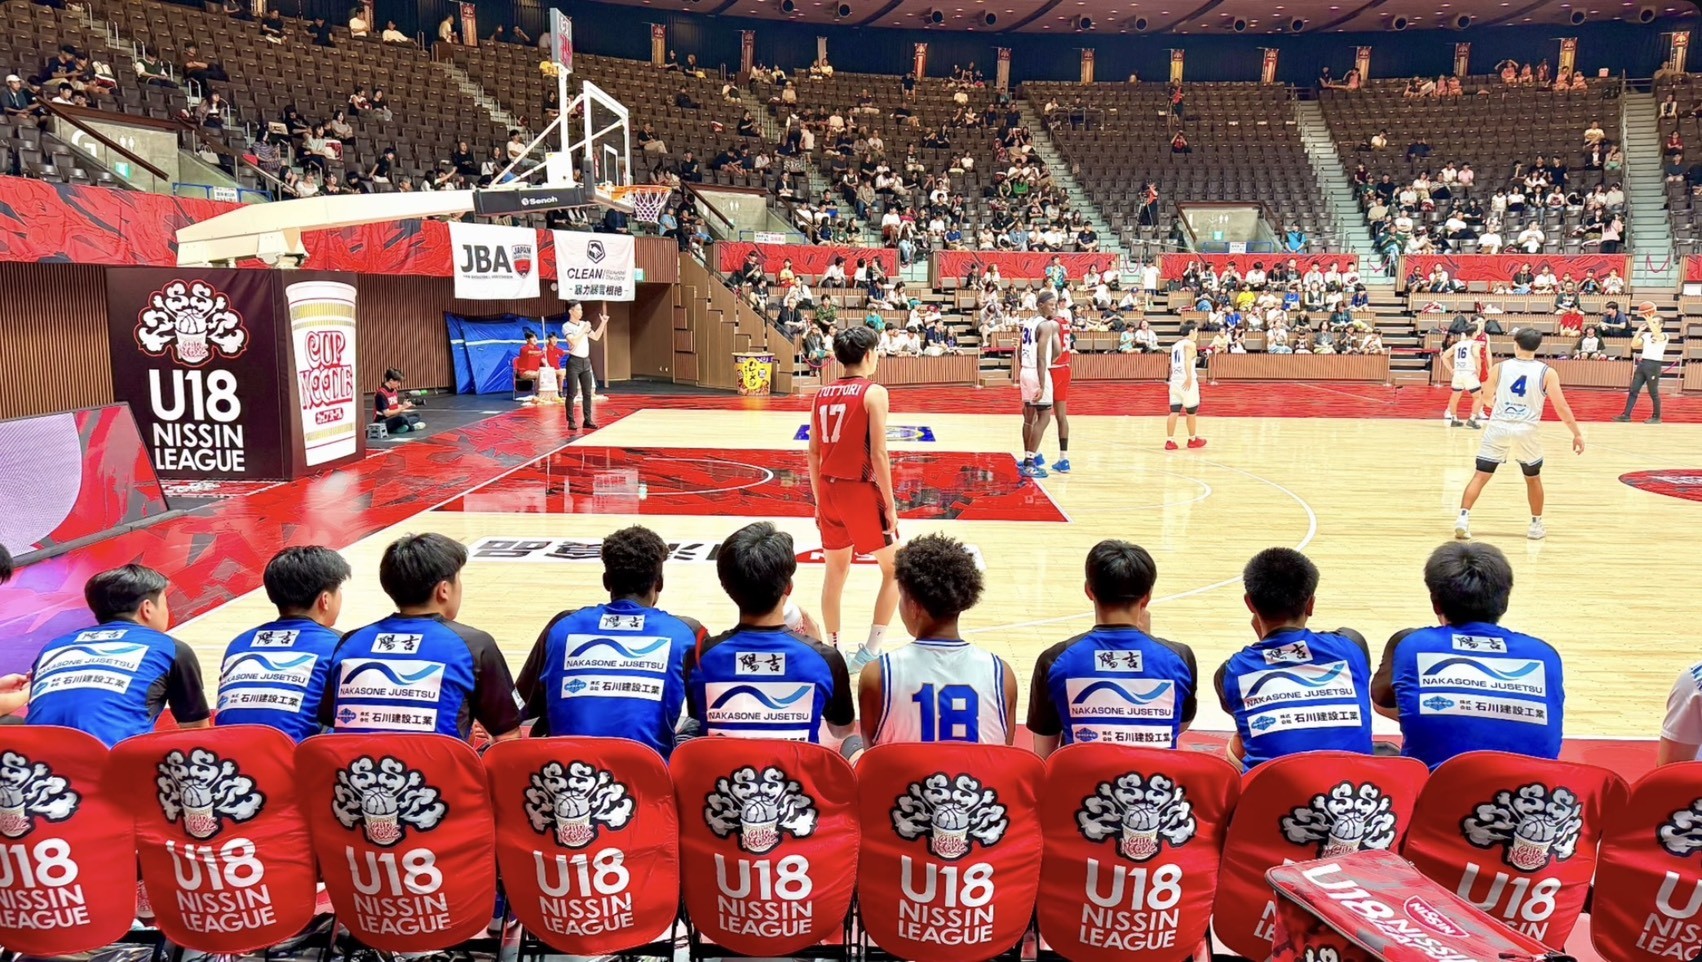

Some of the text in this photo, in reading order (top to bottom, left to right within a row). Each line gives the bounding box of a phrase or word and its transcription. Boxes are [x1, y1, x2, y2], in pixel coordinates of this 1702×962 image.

[529, 195, 558, 205] Senoh
[460, 244, 512, 273] JBA
[567, 267, 603, 280] CLEAN
[305, 331, 346, 369] CUP
[1457, 346, 1467, 359] 16
[148, 369, 241, 422] U18
[299, 365, 353, 410] NOODLE
[819, 383, 862, 398] TOTTORI
[1510, 374, 1527, 397] 4
[153, 422, 244, 448] NISSIN
[819, 403, 847, 443] 17
[155, 448, 245, 471] LEAGUE
[84, 658, 135, 669] JUSETSU
[619, 660, 664, 669] JUSETSU
[63, 674, 126, 688] 石川建設工業
[260, 672, 306, 684] JUSETSU
[602, 681, 660, 695] 石川建設工業
[1422, 678, 1543, 694] NAKASONE JUSETSU
[240, 693, 299, 707] 石川建設工業
[340, 687, 436, 698] NAKASONE JUSETSU
[1246, 687, 1352, 707] NAKASONE JUSETSU
[372, 712, 433, 725] 石川建設工業
[708, 711, 808, 720] NAKASONE JUSETSU
[912, 683, 979, 743] 18
[1071, 706, 1171, 716] NAKASONE JUSETSU
[1294, 711, 1359, 723] 石川建設工業
[1475, 701, 1545, 719] 石川建設工業
[1115, 731, 1170, 742] 石川建設工業
[165, 838, 264, 890] U18
[346, 846, 443, 896] U18
[533, 847, 630, 897] U18
[714, 853, 813, 900] U18
[901, 855, 995, 907] U18
[1085, 857, 1183, 911] U18
[1302, 863, 1395, 921] U18
[1457, 862, 1562, 922] U18
[176, 884, 271, 913] NISSIN
[353, 892, 448, 917] NISSIN
[539, 892, 632, 919] NISSIN
[717, 895, 813, 920] NISSIN
[180, 906, 277, 933] LEAGUE
[357, 913, 451, 935] LEAGUE
[543, 912, 634, 936] LEAGUE
[719, 913, 812, 937] LEAGUE
[899, 899, 994, 927] NISSIN
[1082, 903, 1179, 932] NISSIN
[1409, 902, 1457, 935] NISSIN
[898, 920, 993, 945] LEAGUE
[1079, 924, 1177, 951] LEAGUE
